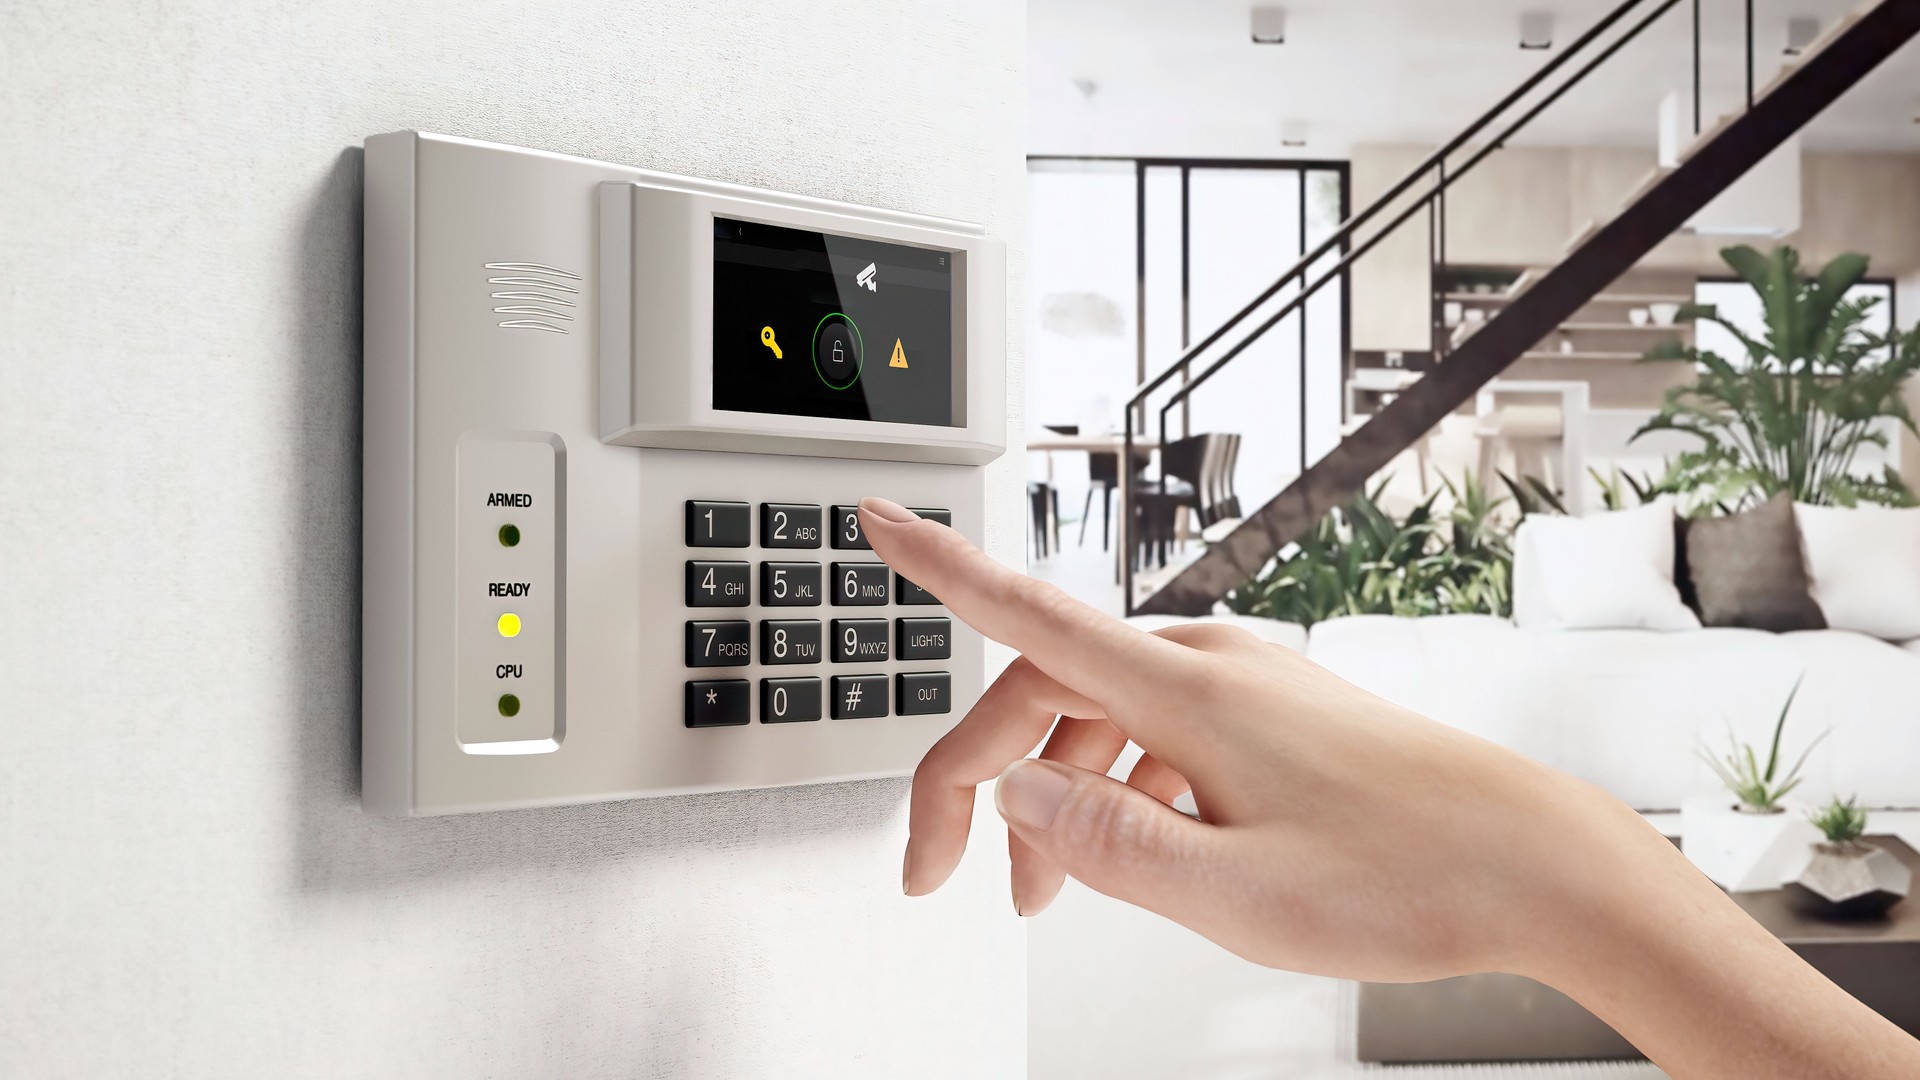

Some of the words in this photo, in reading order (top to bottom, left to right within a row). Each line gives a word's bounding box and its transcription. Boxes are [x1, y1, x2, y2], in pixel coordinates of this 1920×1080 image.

[487, 493, 532, 508] ARMED
[704, 509, 713, 538] 1
[774, 512, 787, 539] 2
[795, 528, 816, 540] ABC
[846, 513, 858, 541] 3
[489, 583, 530, 597] READY
[702, 568, 716, 595] 4
[725, 583, 743, 595] GHI
[774, 570, 787, 598] 5
[795, 585, 813, 597] JKL
[845, 570, 857, 598] 6
[863, 585, 885, 597] MNO
[702, 629, 716, 656] 7
[718, 643, 748, 656] PQRS
[774, 629, 787, 657] 8
[795, 644, 815, 656] TUV
[845, 628, 857, 655] 9
[860, 642, 886, 654] WXYZ
[911, 635, 944, 647] LIGHTS
[496, 664, 522, 678] CPU
[774, 688, 787, 716] 0
[845, 683, 862, 711] #
[918, 688, 937, 700] OUT
